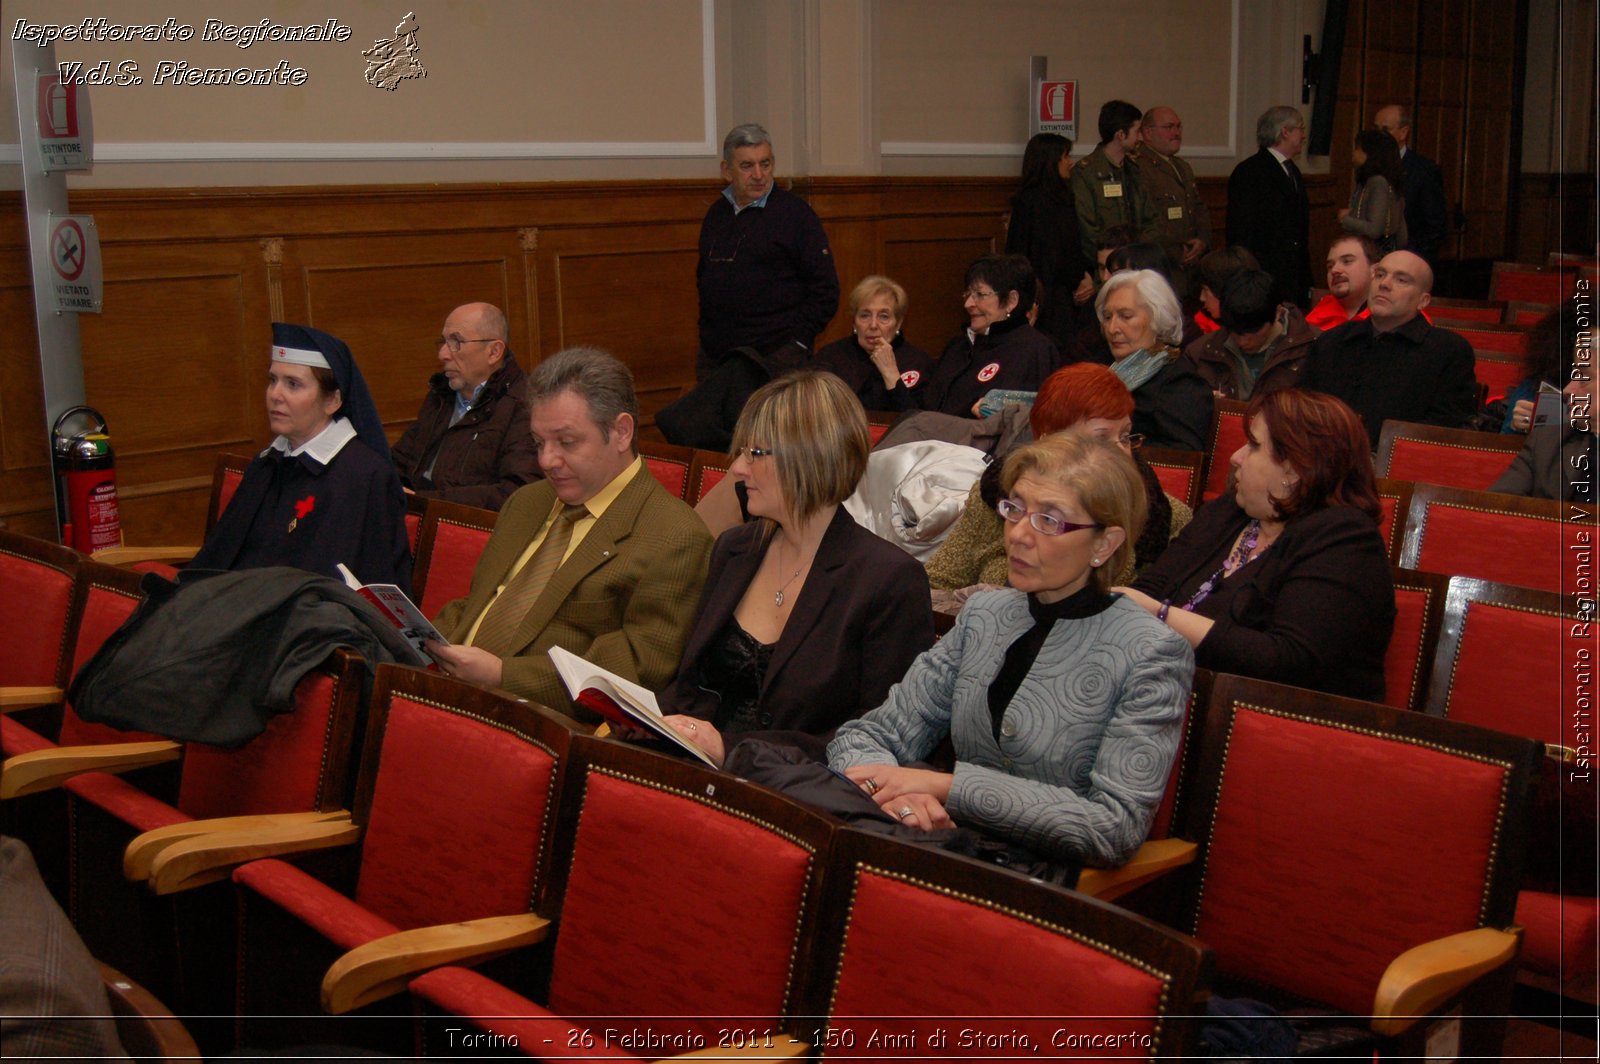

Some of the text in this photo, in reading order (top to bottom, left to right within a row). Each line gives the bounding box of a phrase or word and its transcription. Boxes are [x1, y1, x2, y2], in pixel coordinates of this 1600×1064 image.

[1040, 124, 1073, 132] ESTINTORE
[42, 143, 82, 154] ESTINTORE
[56, 285, 90, 296] VIETATO
[59, 298, 93, 308] FUMARE
